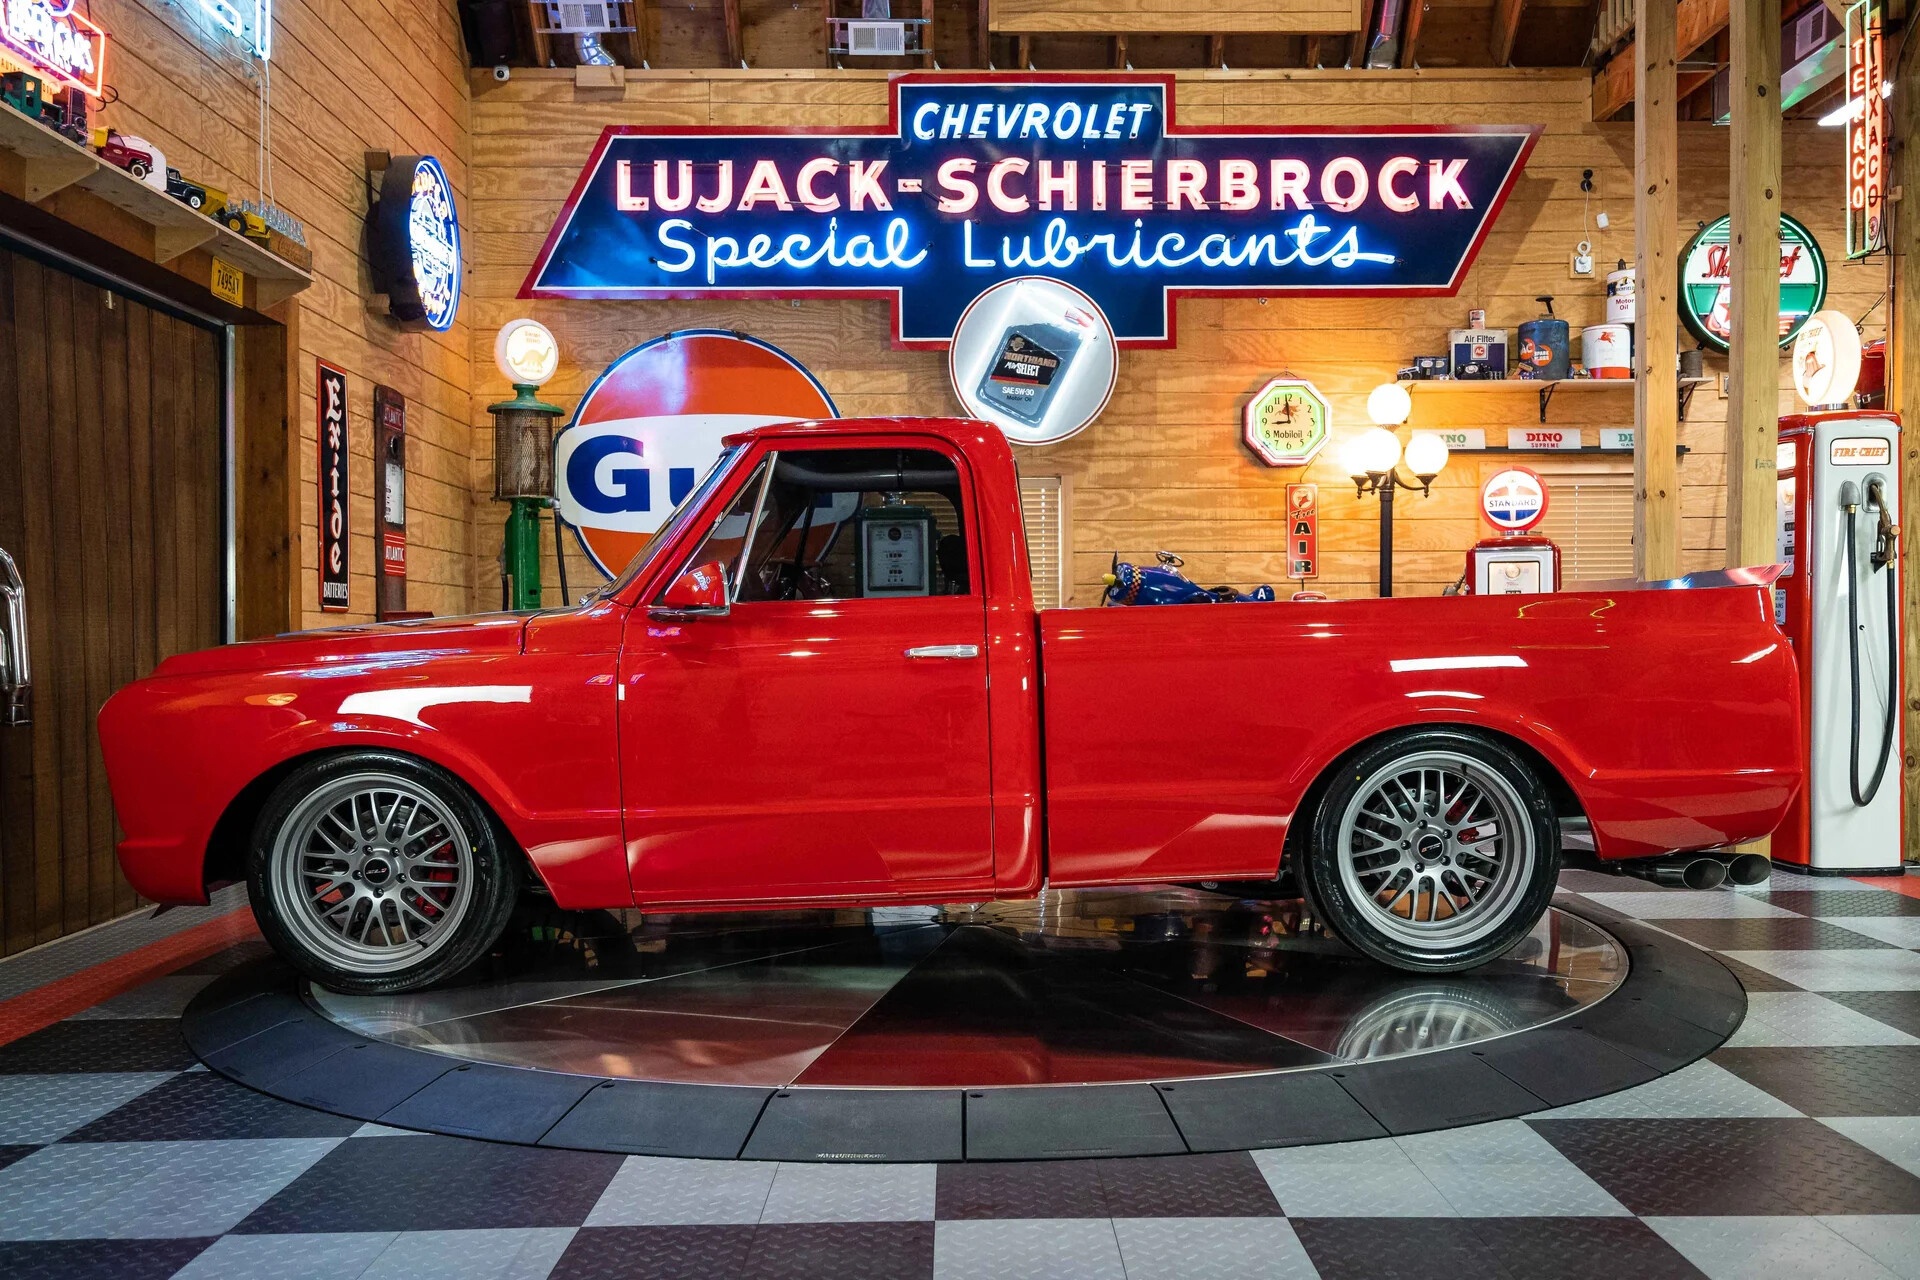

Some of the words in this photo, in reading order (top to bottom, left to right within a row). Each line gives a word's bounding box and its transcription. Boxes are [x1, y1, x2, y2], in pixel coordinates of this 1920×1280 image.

[913, 101, 1153, 140] CHEVROLET
[1867, 36, 1879, 208] TEXACO
[616, 157, 1474, 213] LUJACK-SCHIERBROCK
[657, 217, 928, 285] Special
[964, 213, 1396, 268] Lubricants
[1464, 335, 1475, 343] Air
[1476, 335, 1496, 343] Filter
[1520, 342, 1533, 354] AC
[1004, 351, 1058, 367] NORTHLAND
[1002, 386, 1014, 394] SAE
[1265, 405, 1274, 413] 10
[1307, 405, 1312, 413] 2
[385, 407, 403, 430] ATLANTIC
[1265, 430, 1271, 438] 8
[1273, 430, 1303, 438] Mobiloil
[1307, 430, 1312, 438] 4
[1526, 432, 1563, 442] DINO
[1618, 433, 1634, 442] DI
[1274, 440, 1279, 448] 7
[325, 377, 344, 575] Exide
[1488, 499, 1538, 508] STANDARD
[1290, 508, 1315, 519] Free
[1293, 521, 1312, 573] AIR
[385, 545, 405, 563] ATLANTIC
[323, 581, 348, 600] BATTERIES
